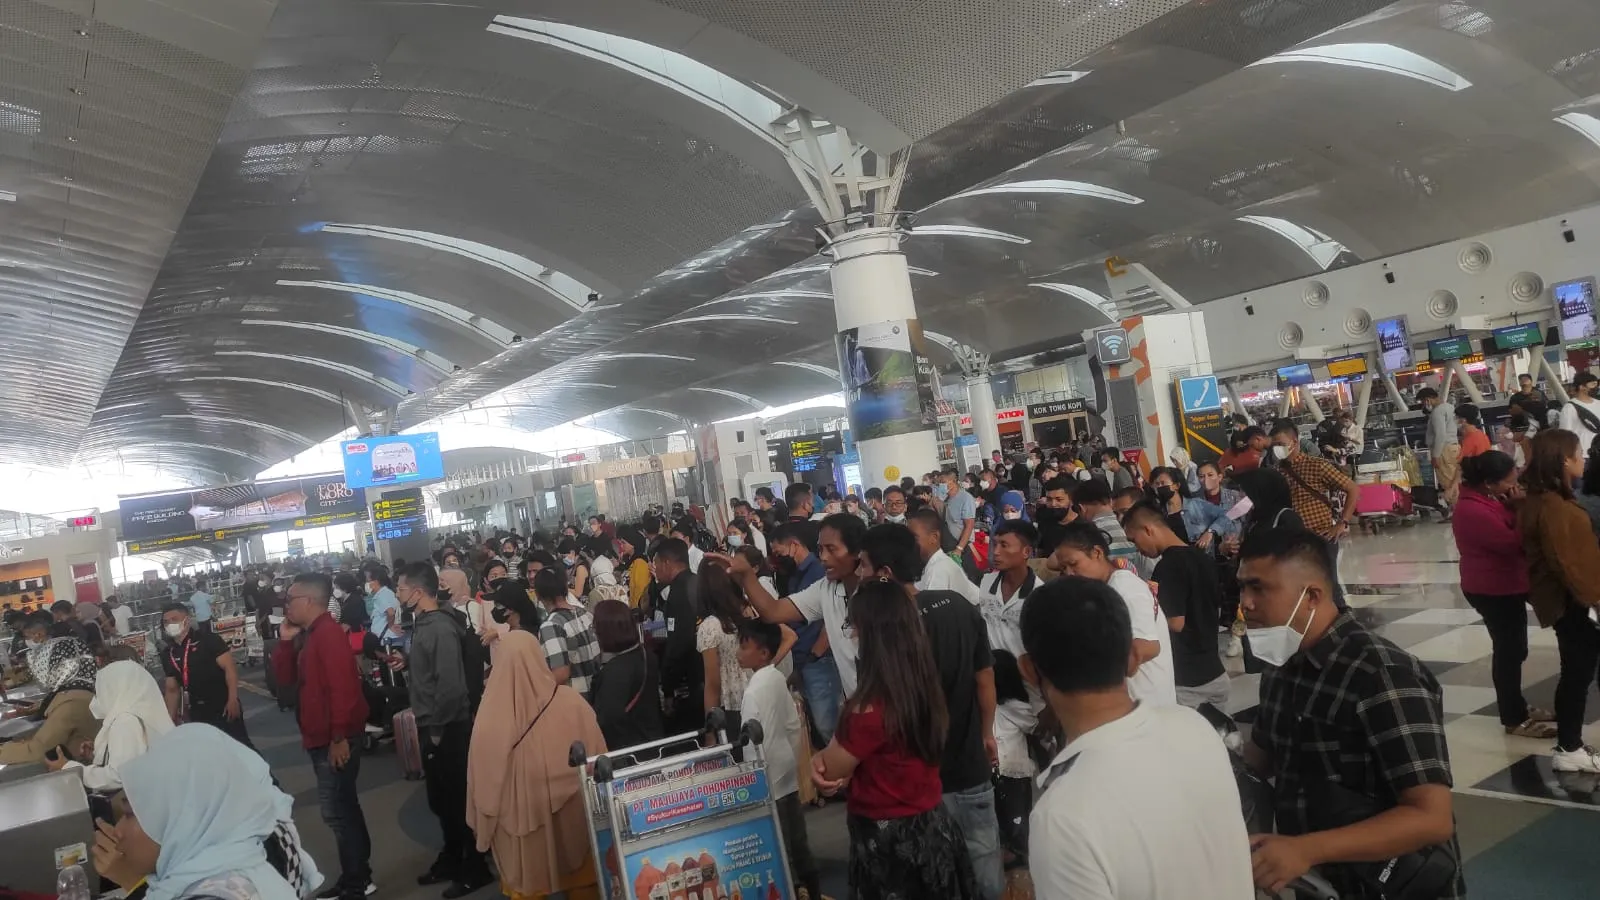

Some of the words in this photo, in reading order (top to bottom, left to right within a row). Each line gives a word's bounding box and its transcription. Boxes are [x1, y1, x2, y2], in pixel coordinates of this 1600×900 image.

[1033, 405, 1048, 415] KOK
[1049, 403, 1066, 412] TONG
[1067, 400, 1082, 410] KOPI
[931, 598, 951, 608] MIND
[650, 788, 695, 809] MAJUJAYA
[697, 773, 757, 798] POHONPINANG
